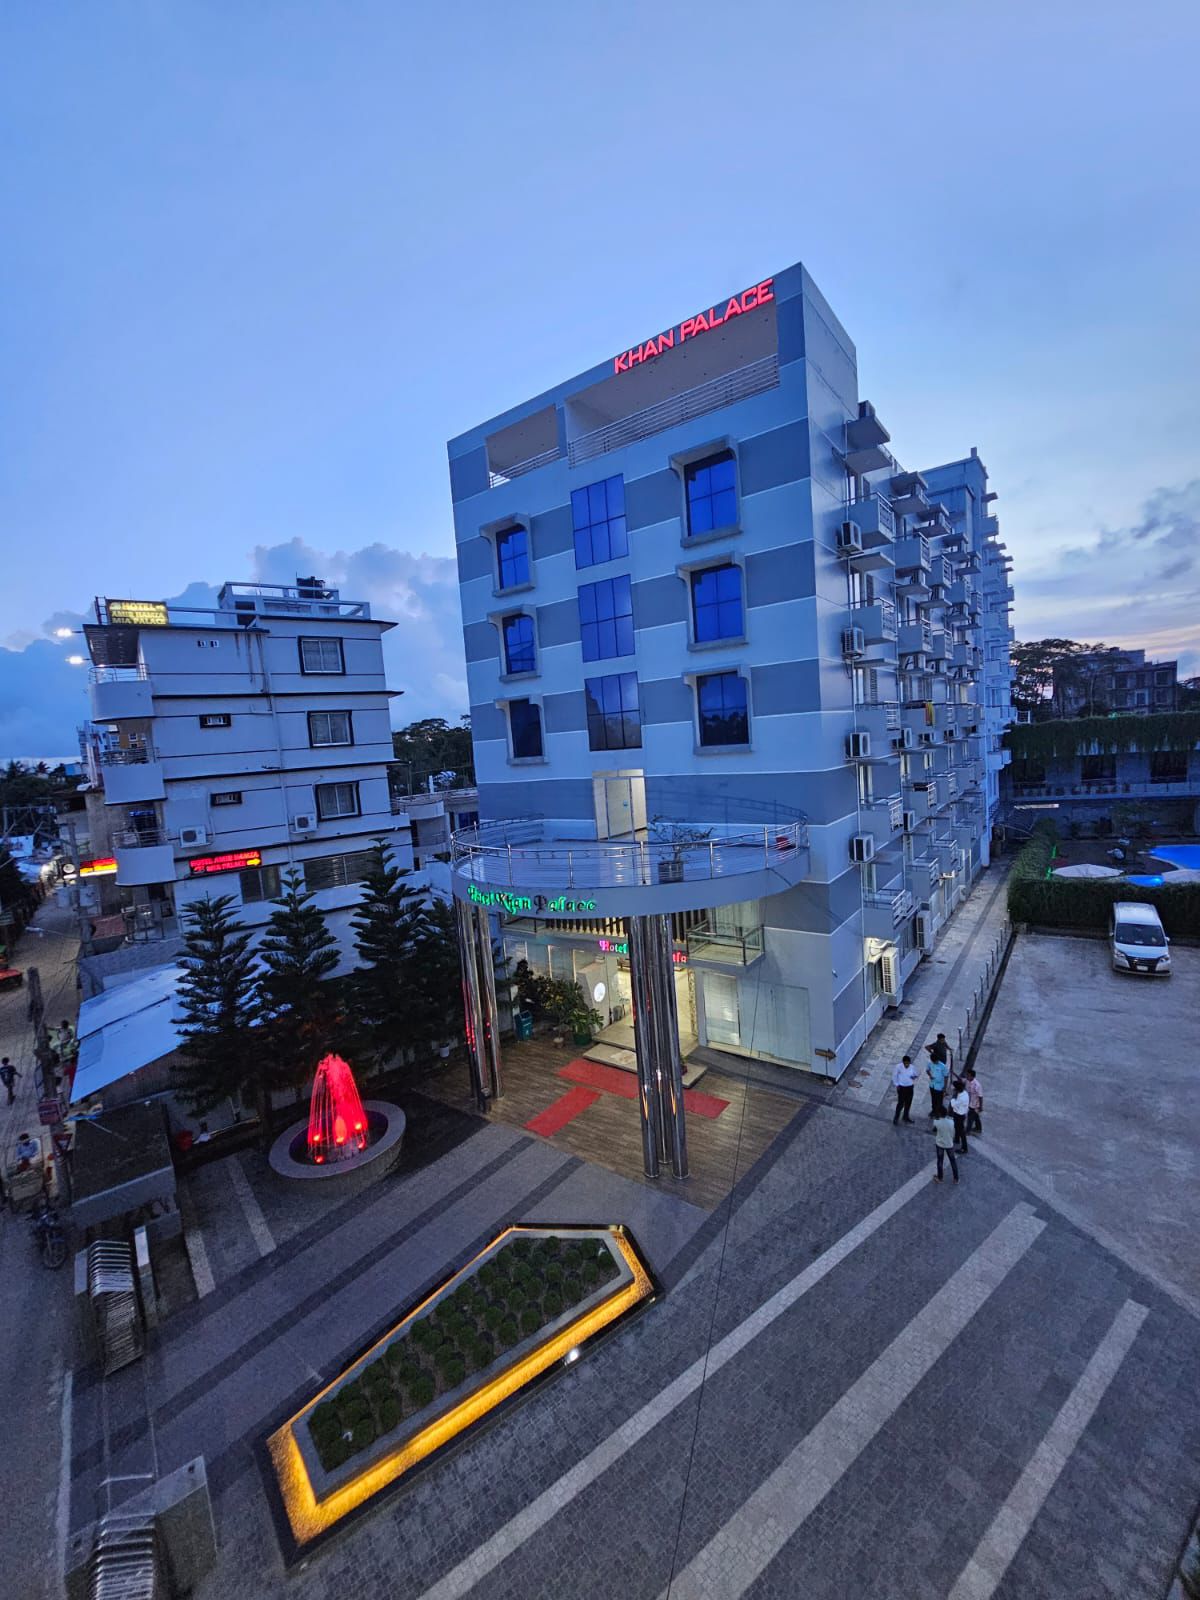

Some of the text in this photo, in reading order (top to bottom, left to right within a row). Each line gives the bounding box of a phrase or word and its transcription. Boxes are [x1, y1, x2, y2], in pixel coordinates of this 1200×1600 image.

[613, 278, 775, 375] KHAN PALACE
[122, 602, 154, 612] HOTEL
[533, 894, 597, 915] Palace
[599, 940, 627, 954] Hotel
